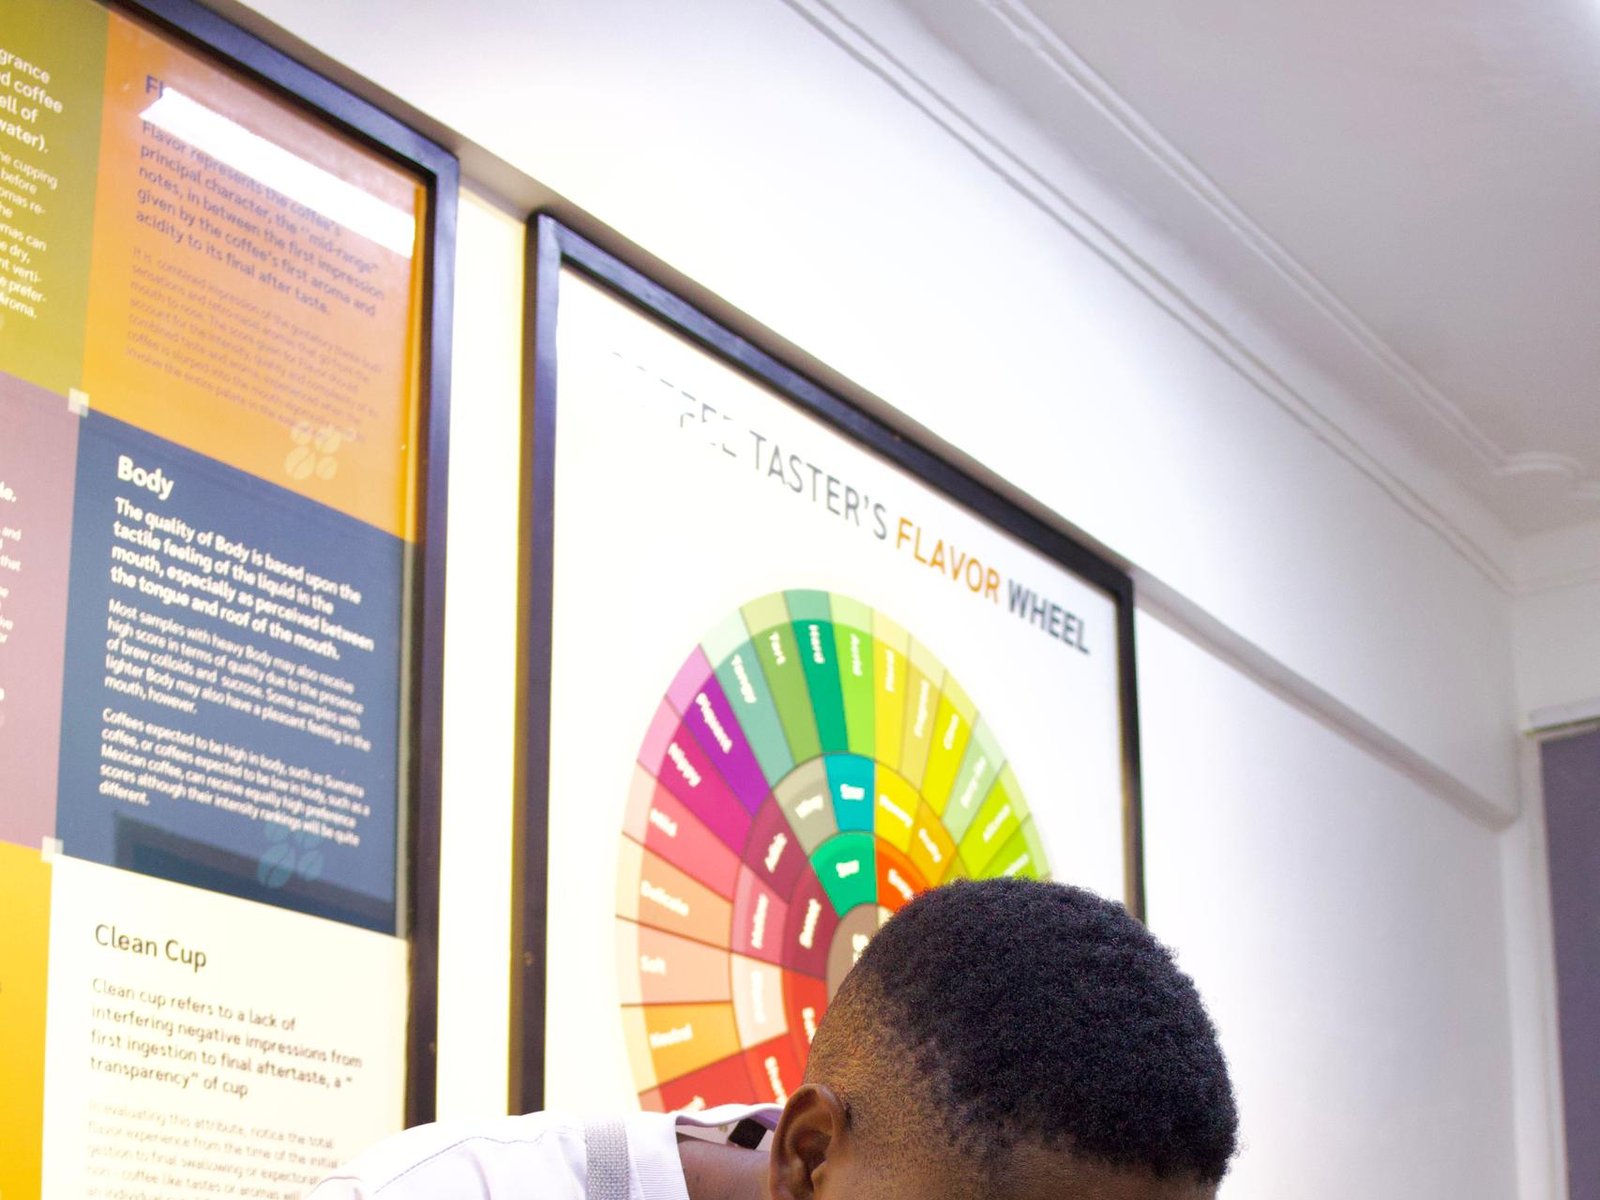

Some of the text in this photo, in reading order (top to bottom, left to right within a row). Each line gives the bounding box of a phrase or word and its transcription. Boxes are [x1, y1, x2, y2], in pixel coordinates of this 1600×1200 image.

[14, 80, 63, 114] coffee
[21, 107, 38, 124] of
[13, 159, 58, 190] cupping
[140, 145, 201, 184] principal
[275, 214, 296, 234] the
[136, 211, 183, 243] acidity
[188, 234, 202, 250] to
[206, 242, 222, 261] its
[226, 252, 254, 276] final
[258, 273, 290, 293] after
[137, 189, 175, 214] given
[179, 207, 195, 226] by
[199, 217, 221, 237] the
[281, 258, 307, 281] first
[311, 277, 350, 303] aroma
[353, 300, 375, 316] and
[139, 167, 384, 300] notes, in between the first impression
[117, 455, 173, 499] Body
[113, 521, 333, 614] tactile feeling of the liquid in the
[115, 497, 361, 603] The quality of Body is based upon the
[896, 516, 1000, 604] FLAVOR
[1008, 578, 1091, 655] WHEEL
[110, 566, 339, 659] the tongue and roof of the mouth.
[111, 546, 373, 650] mouth, especially as perceived between
[108, 599, 354, 693] Most samples with heavy Body may also receive
[95, 924, 206, 973] Clean Cup
[92, 978, 296, 1030] Clean cup refers to a lack of
[92, 1008, 361, 1067] interfering negative impressions from
[90, 1029, 122, 1048] first
[127, 1039, 196, 1061] ingestion
[201, 1050, 217, 1066] to
[220, 1052, 251, 1071] final
[333, 1077, 341, 1088] a
[202, 1076, 218, 1090] of
[222, 1081, 248, 1099] cup
